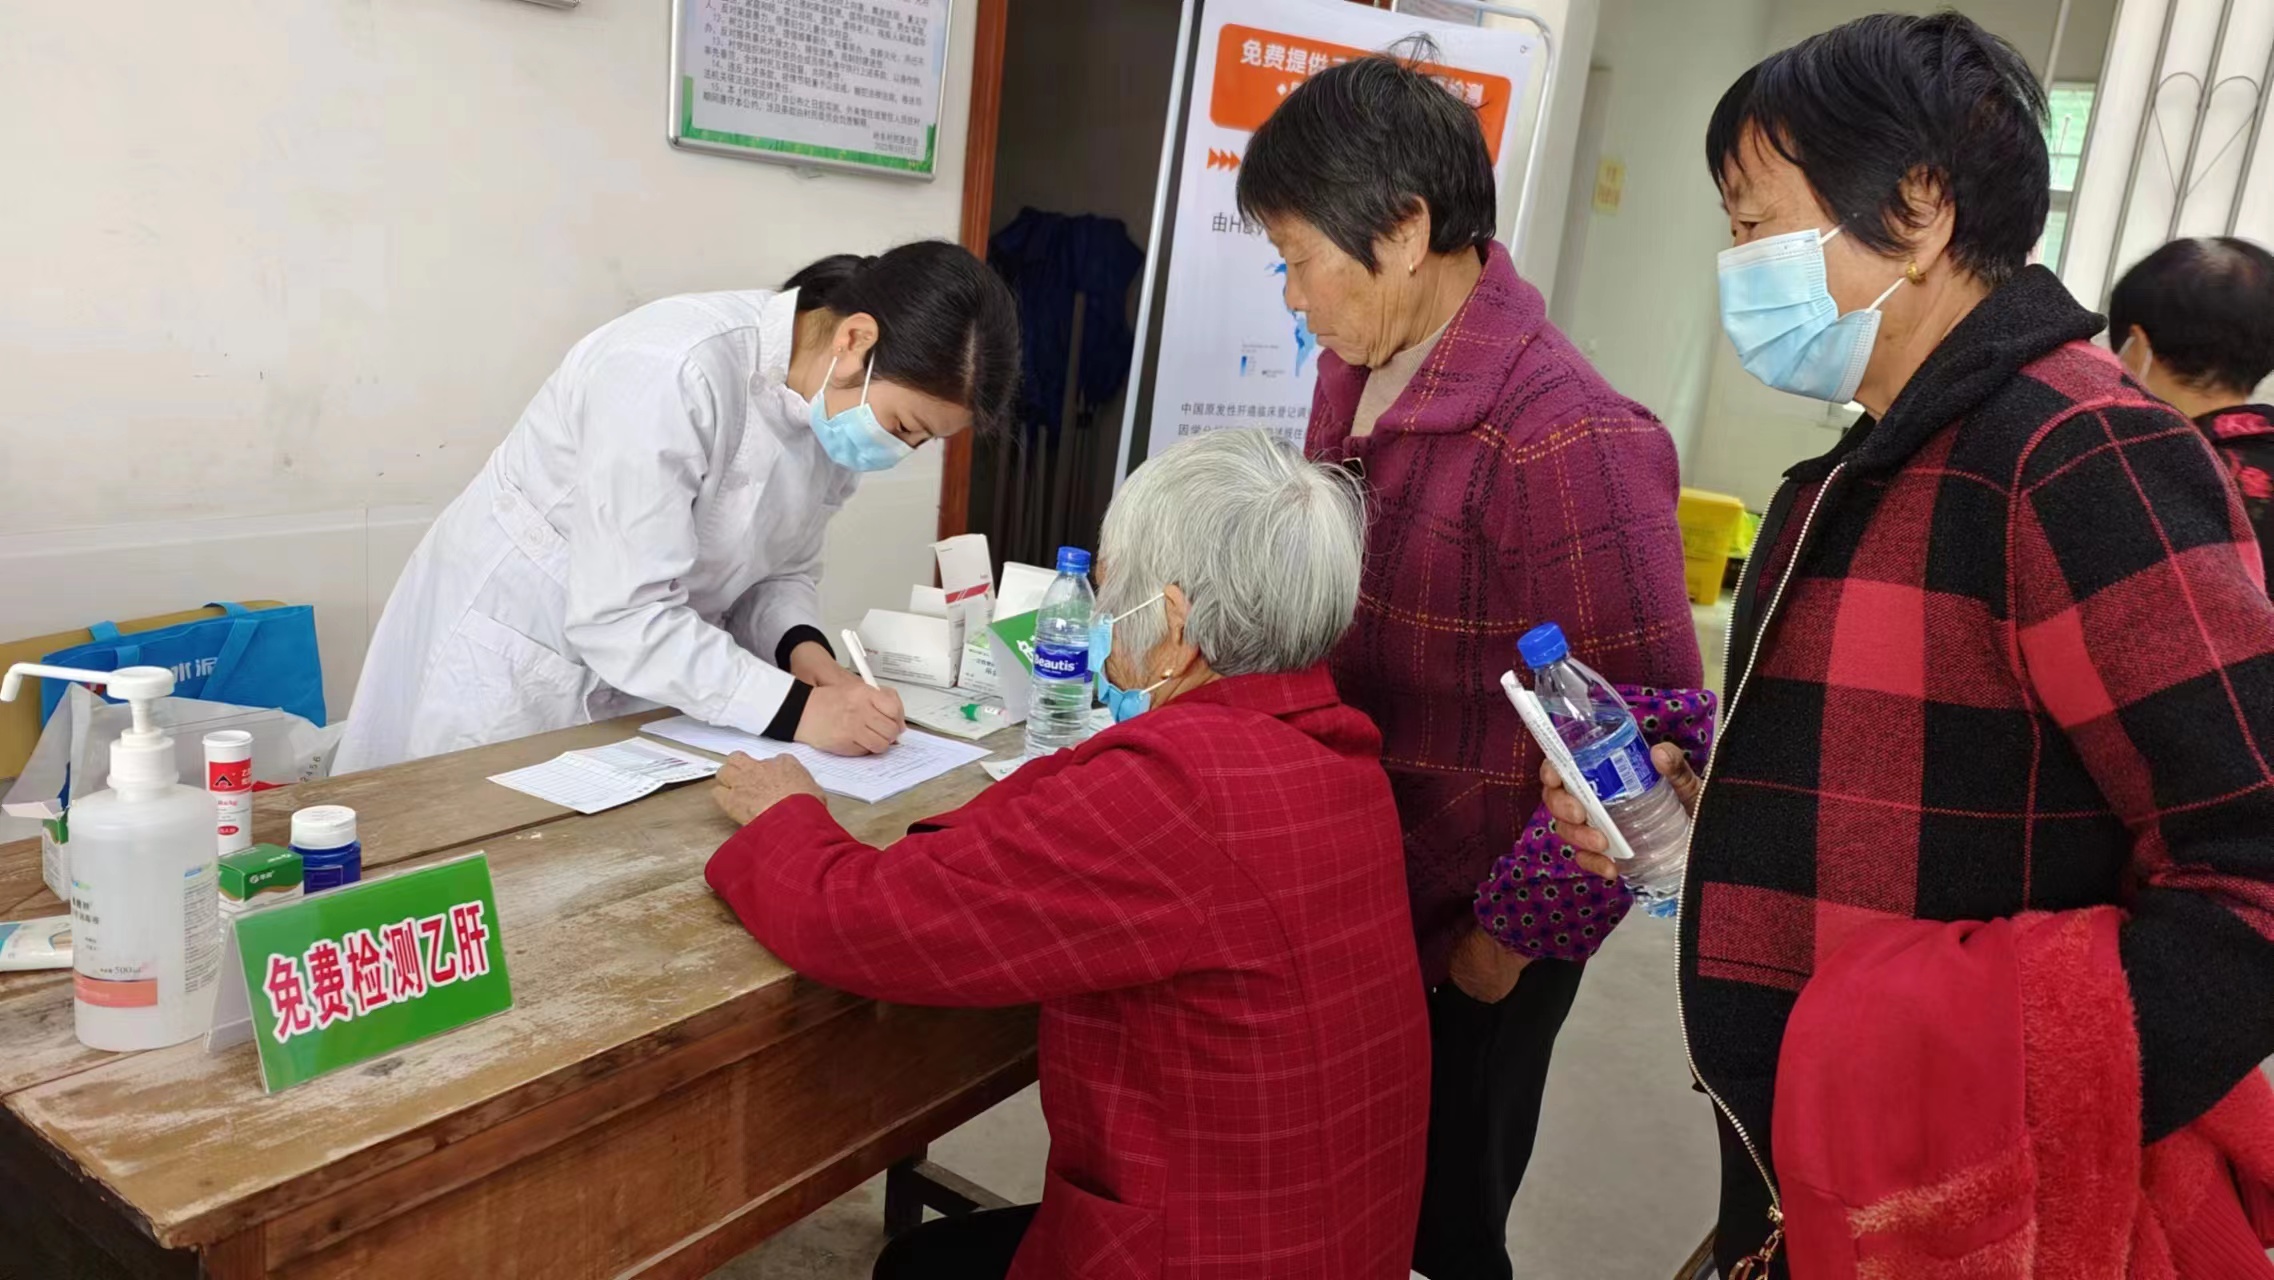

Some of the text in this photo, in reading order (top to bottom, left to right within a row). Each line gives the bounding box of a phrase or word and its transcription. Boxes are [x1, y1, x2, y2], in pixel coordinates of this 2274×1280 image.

[1240, 38, 1347, 75] 免费提供
[1181, 402, 1312, 418] 中国原发性肝癌临床登记调
[1034, 653, 1075, 672] Beautis
[264, 901, 489, 1042] 免费检测乙肝
